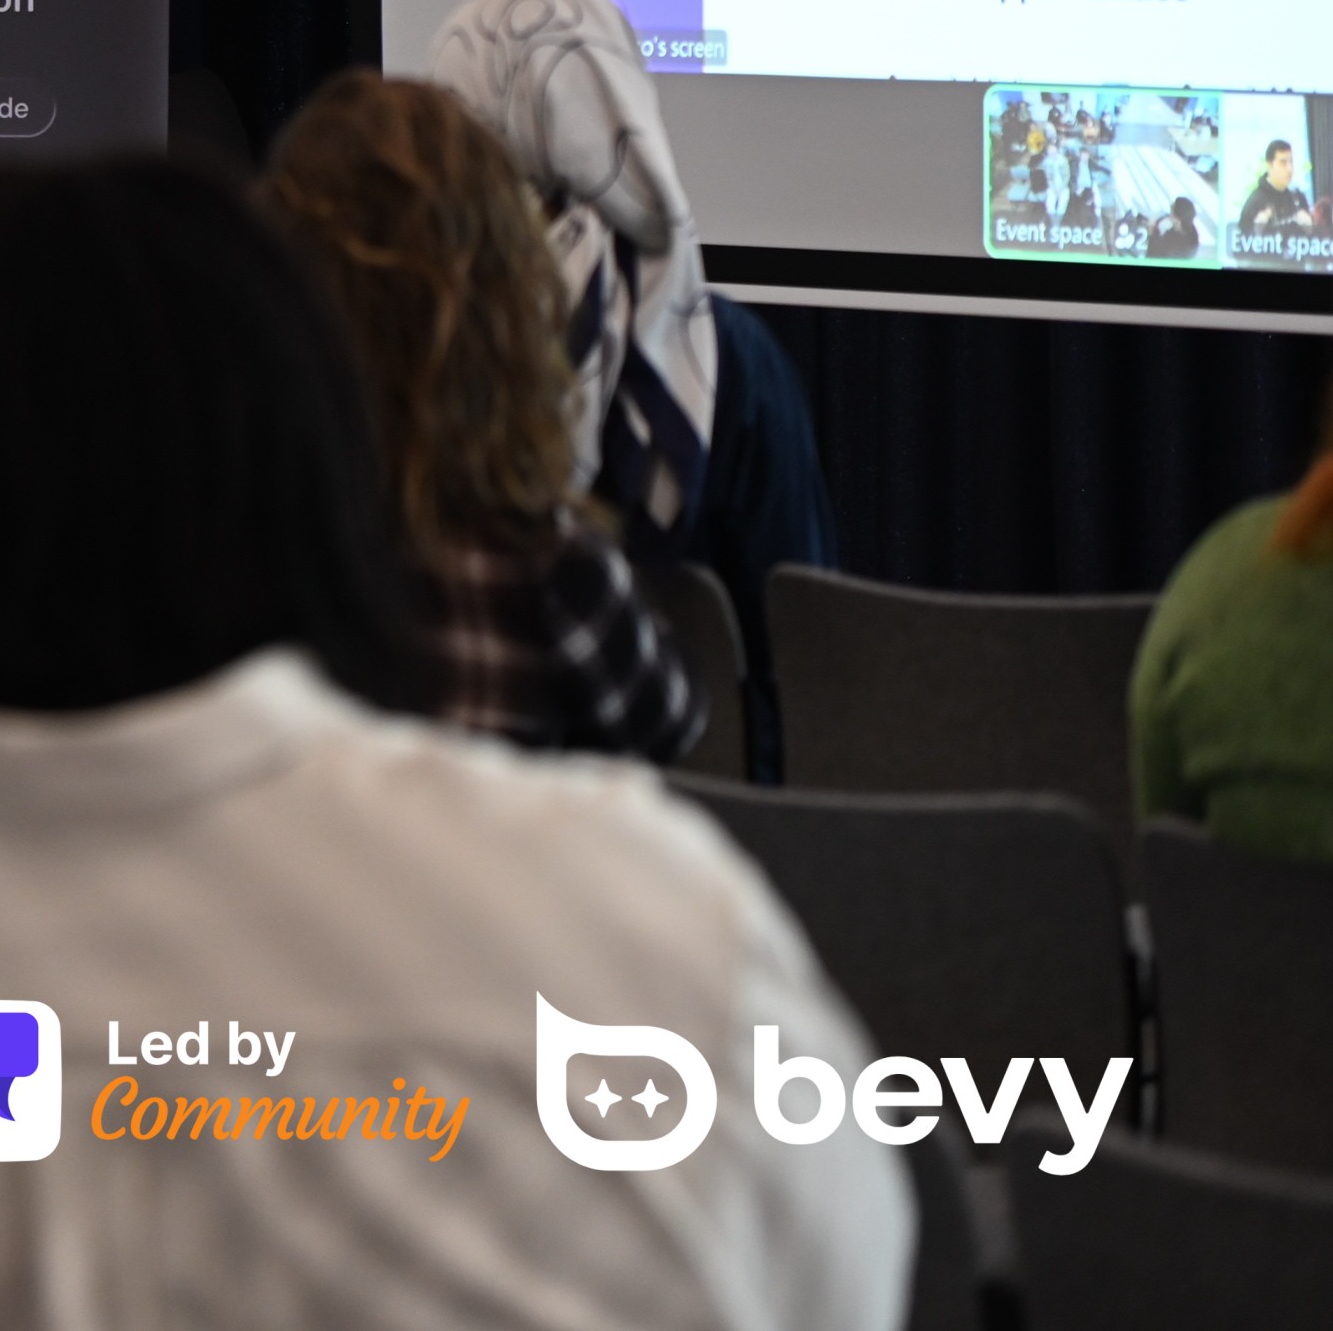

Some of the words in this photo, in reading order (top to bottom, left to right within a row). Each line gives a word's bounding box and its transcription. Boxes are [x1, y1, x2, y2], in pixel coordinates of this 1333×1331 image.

[670, 39, 725, 59] screen
[996, 219, 1046, 243] Event
[1049, 226, 1102, 249] space
[1231, 230, 1282, 255] Event
